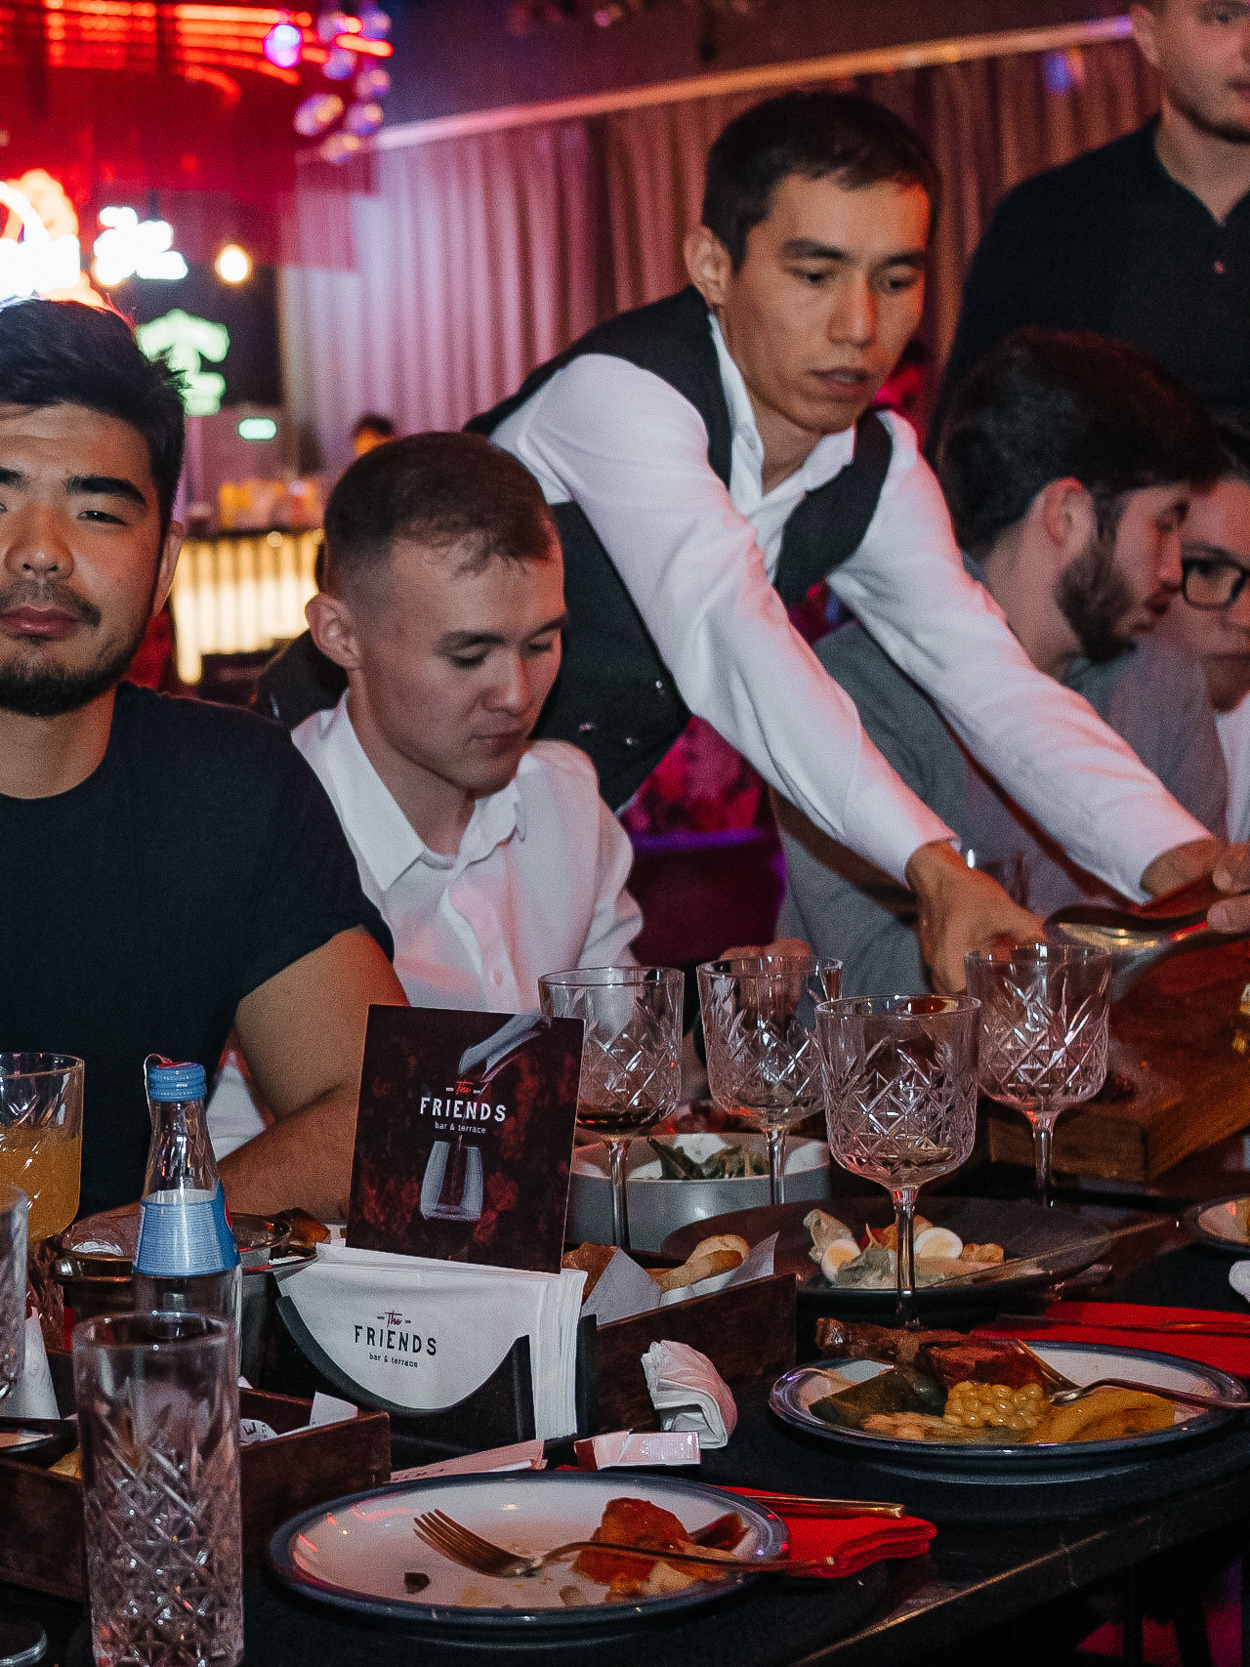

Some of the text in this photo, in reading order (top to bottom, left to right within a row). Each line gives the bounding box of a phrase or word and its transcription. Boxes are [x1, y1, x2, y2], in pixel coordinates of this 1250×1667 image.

[455, 1080, 474, 1095] The
[419, 1096, 507, 1122] FRIENDS
[434, 1121, 487, 1134] bar & terrace
[384, 1310, 402, 1328] The
[353, 1324, 438, 1356] FRIENDS
[368, 1352, 419, 1368] bar & terrace
